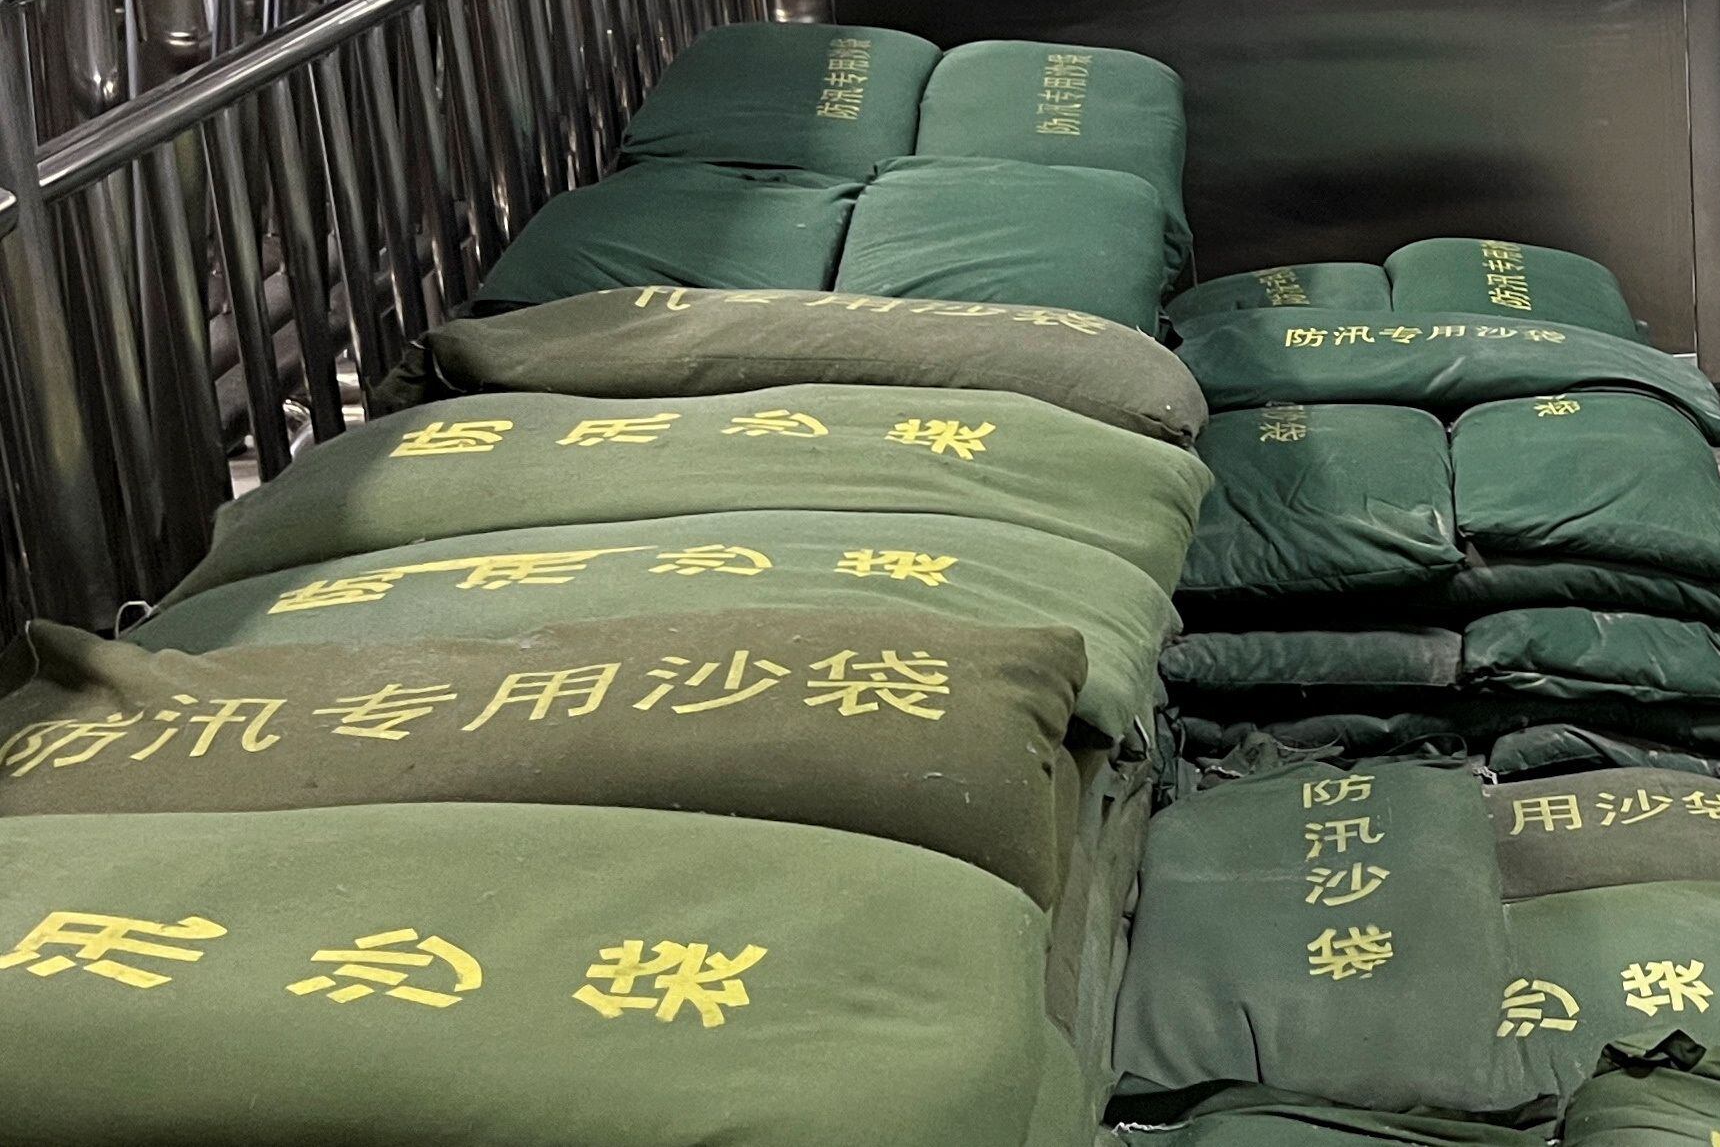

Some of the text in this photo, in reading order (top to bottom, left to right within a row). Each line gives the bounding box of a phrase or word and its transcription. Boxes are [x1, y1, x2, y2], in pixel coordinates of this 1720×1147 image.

[1284, 324, 1567, 349] 防汛专用沙袋
[1, 648, 952, 778] 防汛专用沙袋
[1302, 773, 1394, 981] 防汛沙袋
[1495, 957, 1715, 1038] 沙袋
